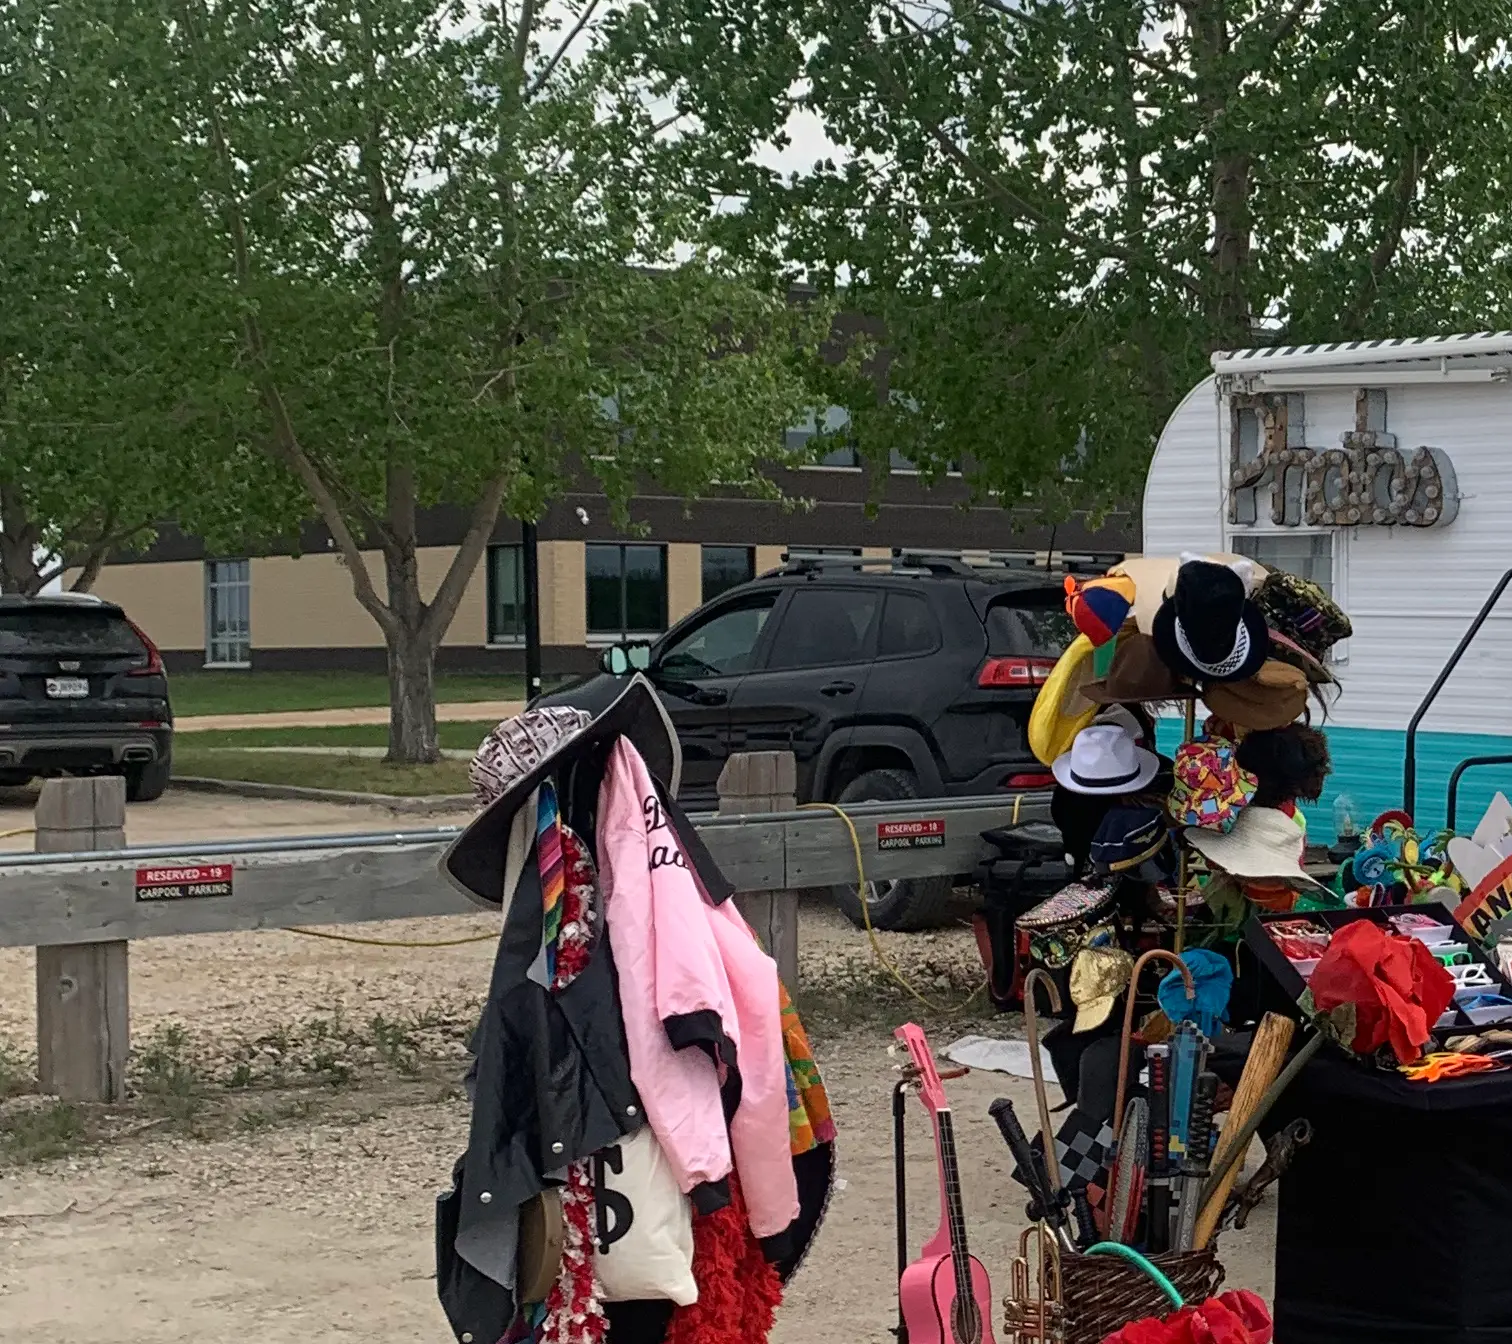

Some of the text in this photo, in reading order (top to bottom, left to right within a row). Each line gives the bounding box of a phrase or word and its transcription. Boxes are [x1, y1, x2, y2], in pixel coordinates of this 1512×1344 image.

[885, 823, 922, 833] RESERVED
[880, 836, 943, 849] CARPOOL PARKING
[146, 868, 200, 881] RESERVED
[139, 883, 230, 899] CARPOOL PARKING
